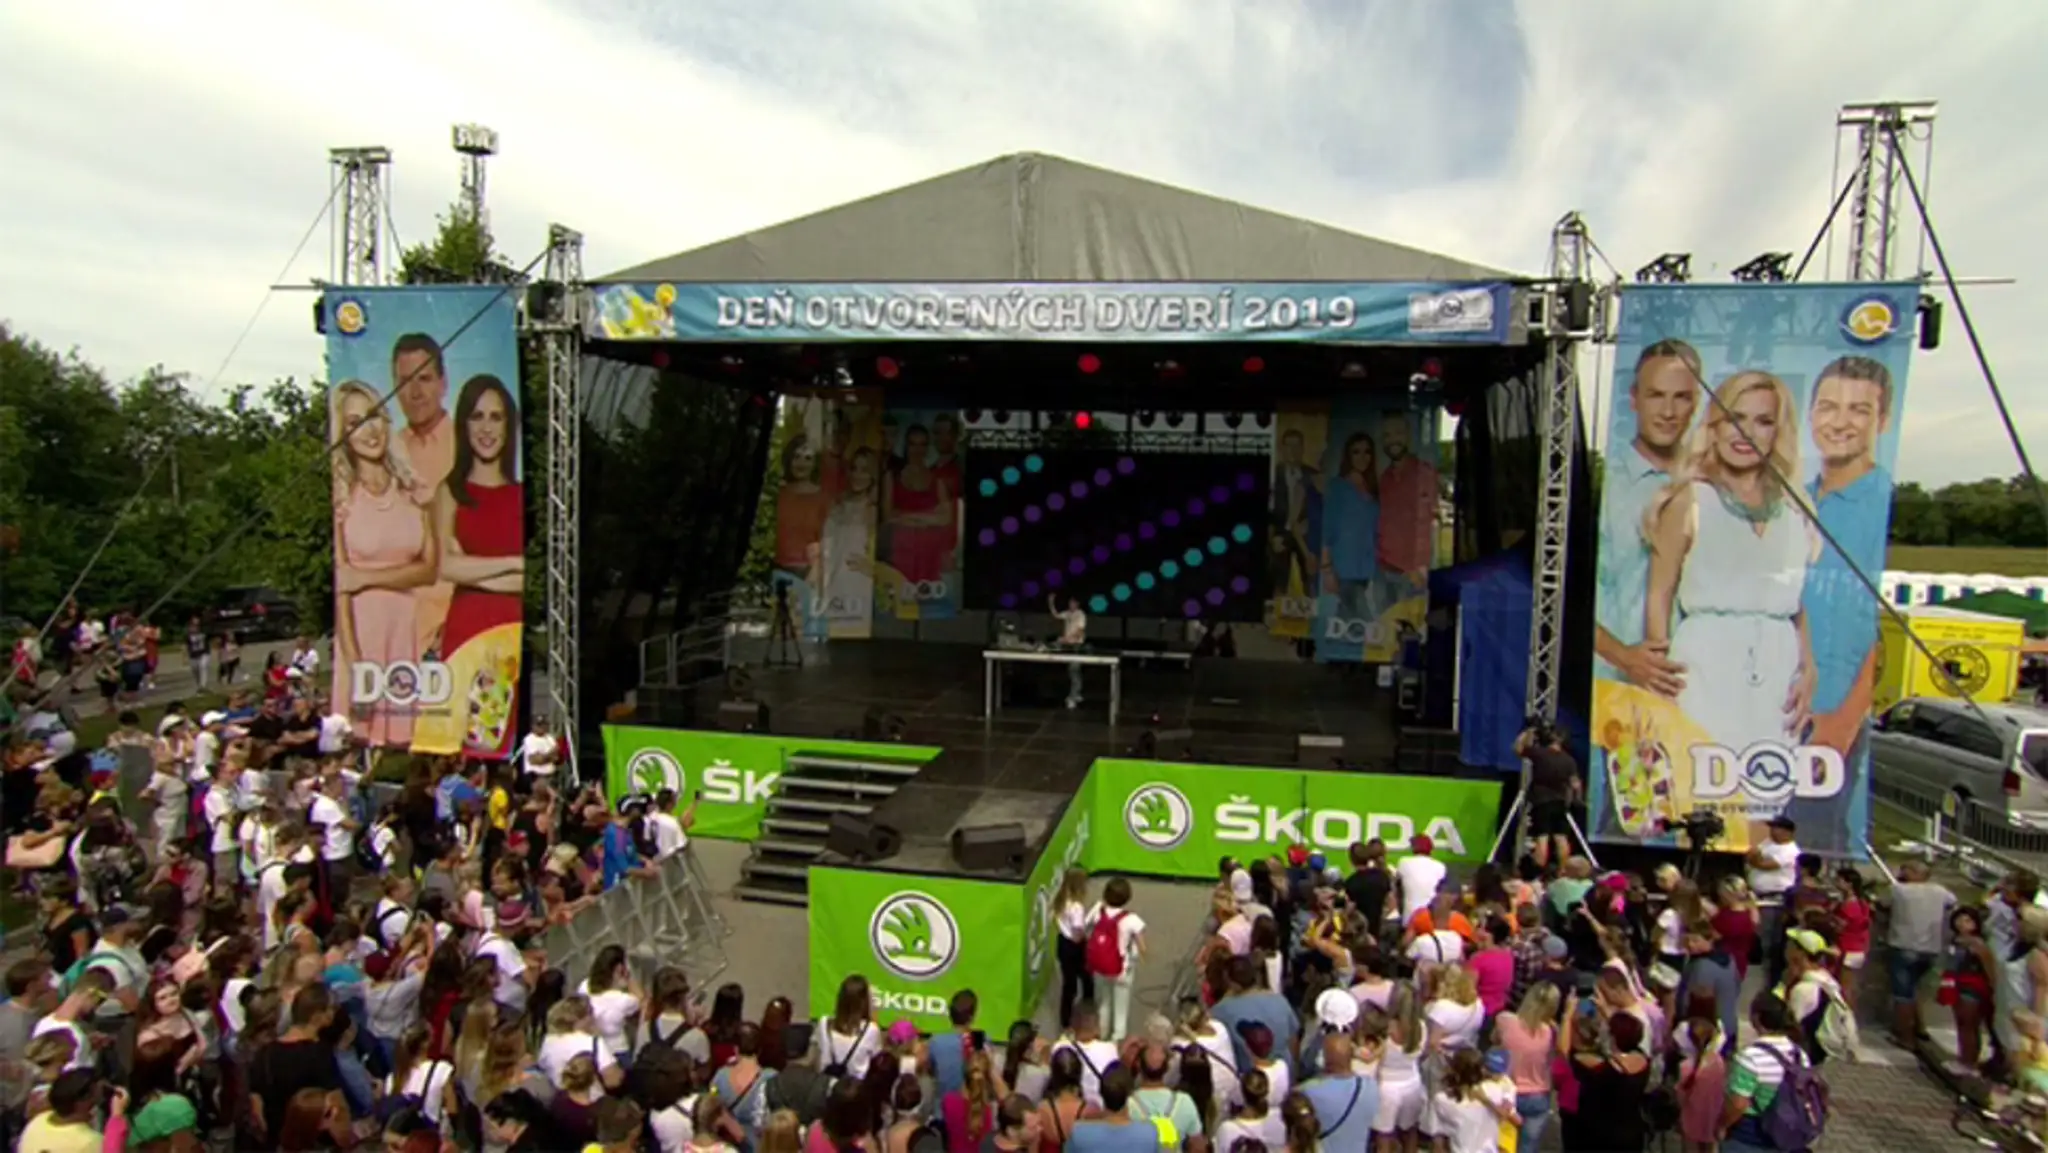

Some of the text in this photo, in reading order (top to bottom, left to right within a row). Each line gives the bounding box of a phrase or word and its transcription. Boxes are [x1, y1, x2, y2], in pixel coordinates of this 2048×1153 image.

[717, 287, 1357, 331] DEŇ OTVORENÝCH DVERÍ 2019
[352, 659, 455, 705] DOD
[1688, 738, 1845, 801] DOD
[1214, 794, 1466, 856] ŠKODA
